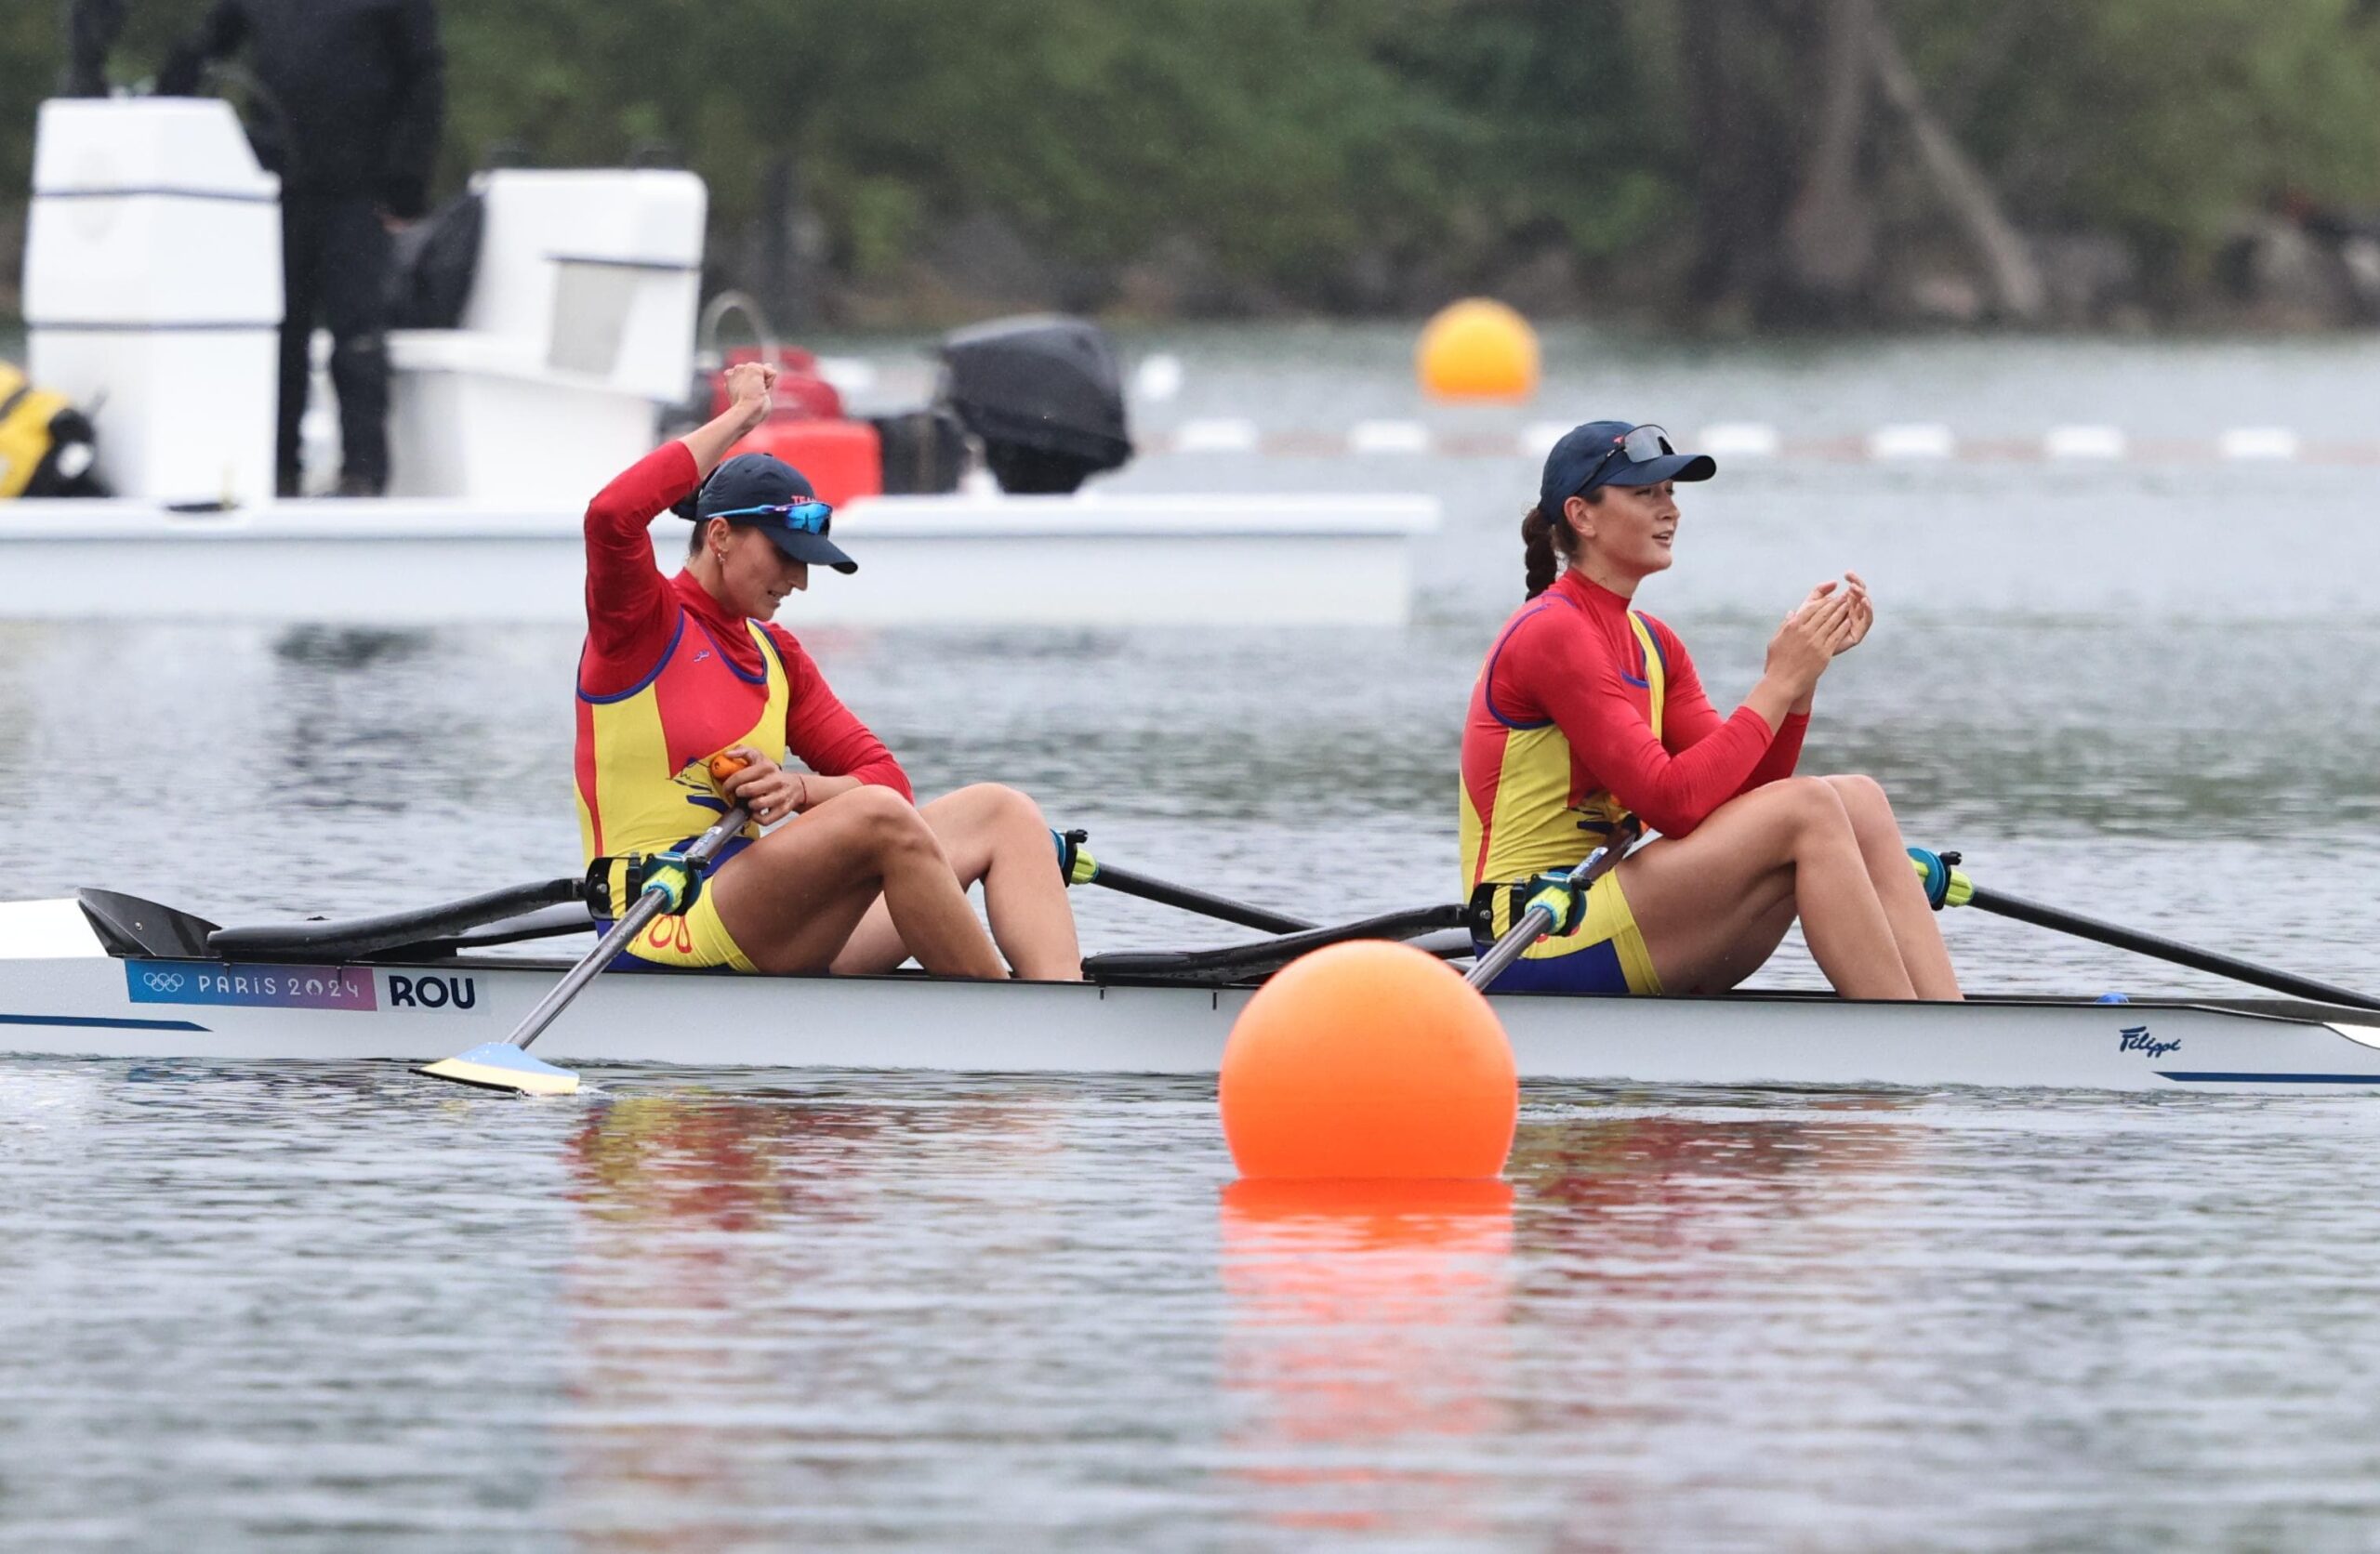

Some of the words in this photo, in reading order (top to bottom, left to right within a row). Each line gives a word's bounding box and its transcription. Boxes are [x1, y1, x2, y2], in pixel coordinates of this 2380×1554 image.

[287, 977, 359, 998] 2024
[388, 974, 476, 1010] ROU
[2119, 1025, 2182, 1059] Filippi
